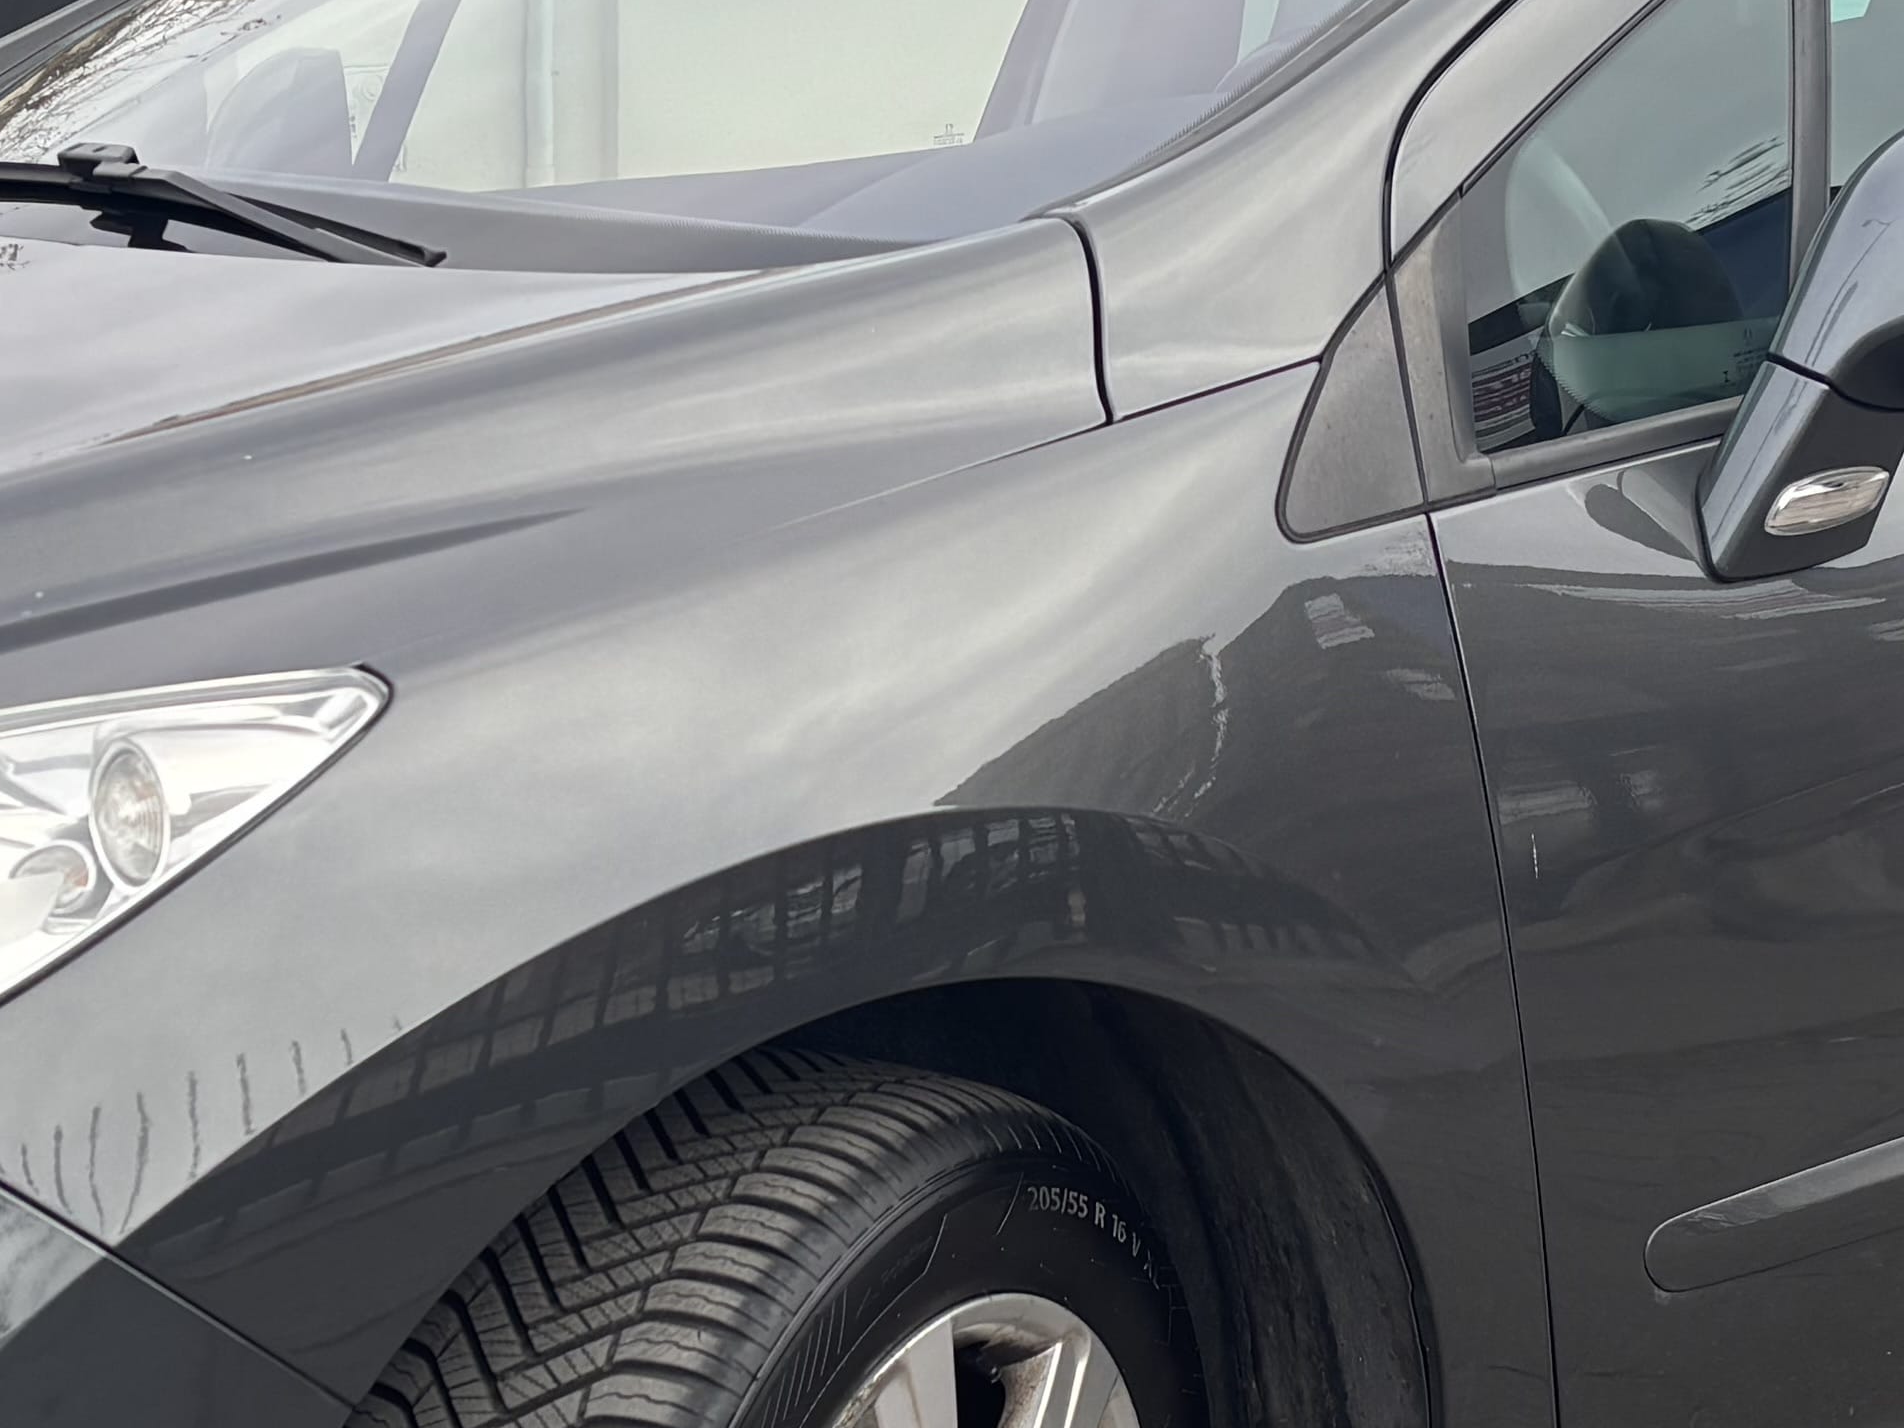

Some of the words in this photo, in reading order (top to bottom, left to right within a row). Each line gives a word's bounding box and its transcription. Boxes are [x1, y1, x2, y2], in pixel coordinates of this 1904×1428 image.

[1026, 1186, 1089, 1219] 205/55
[1094, 1201, 1106, 1229] R
[1111, 1213, 1127, 1244] 16
